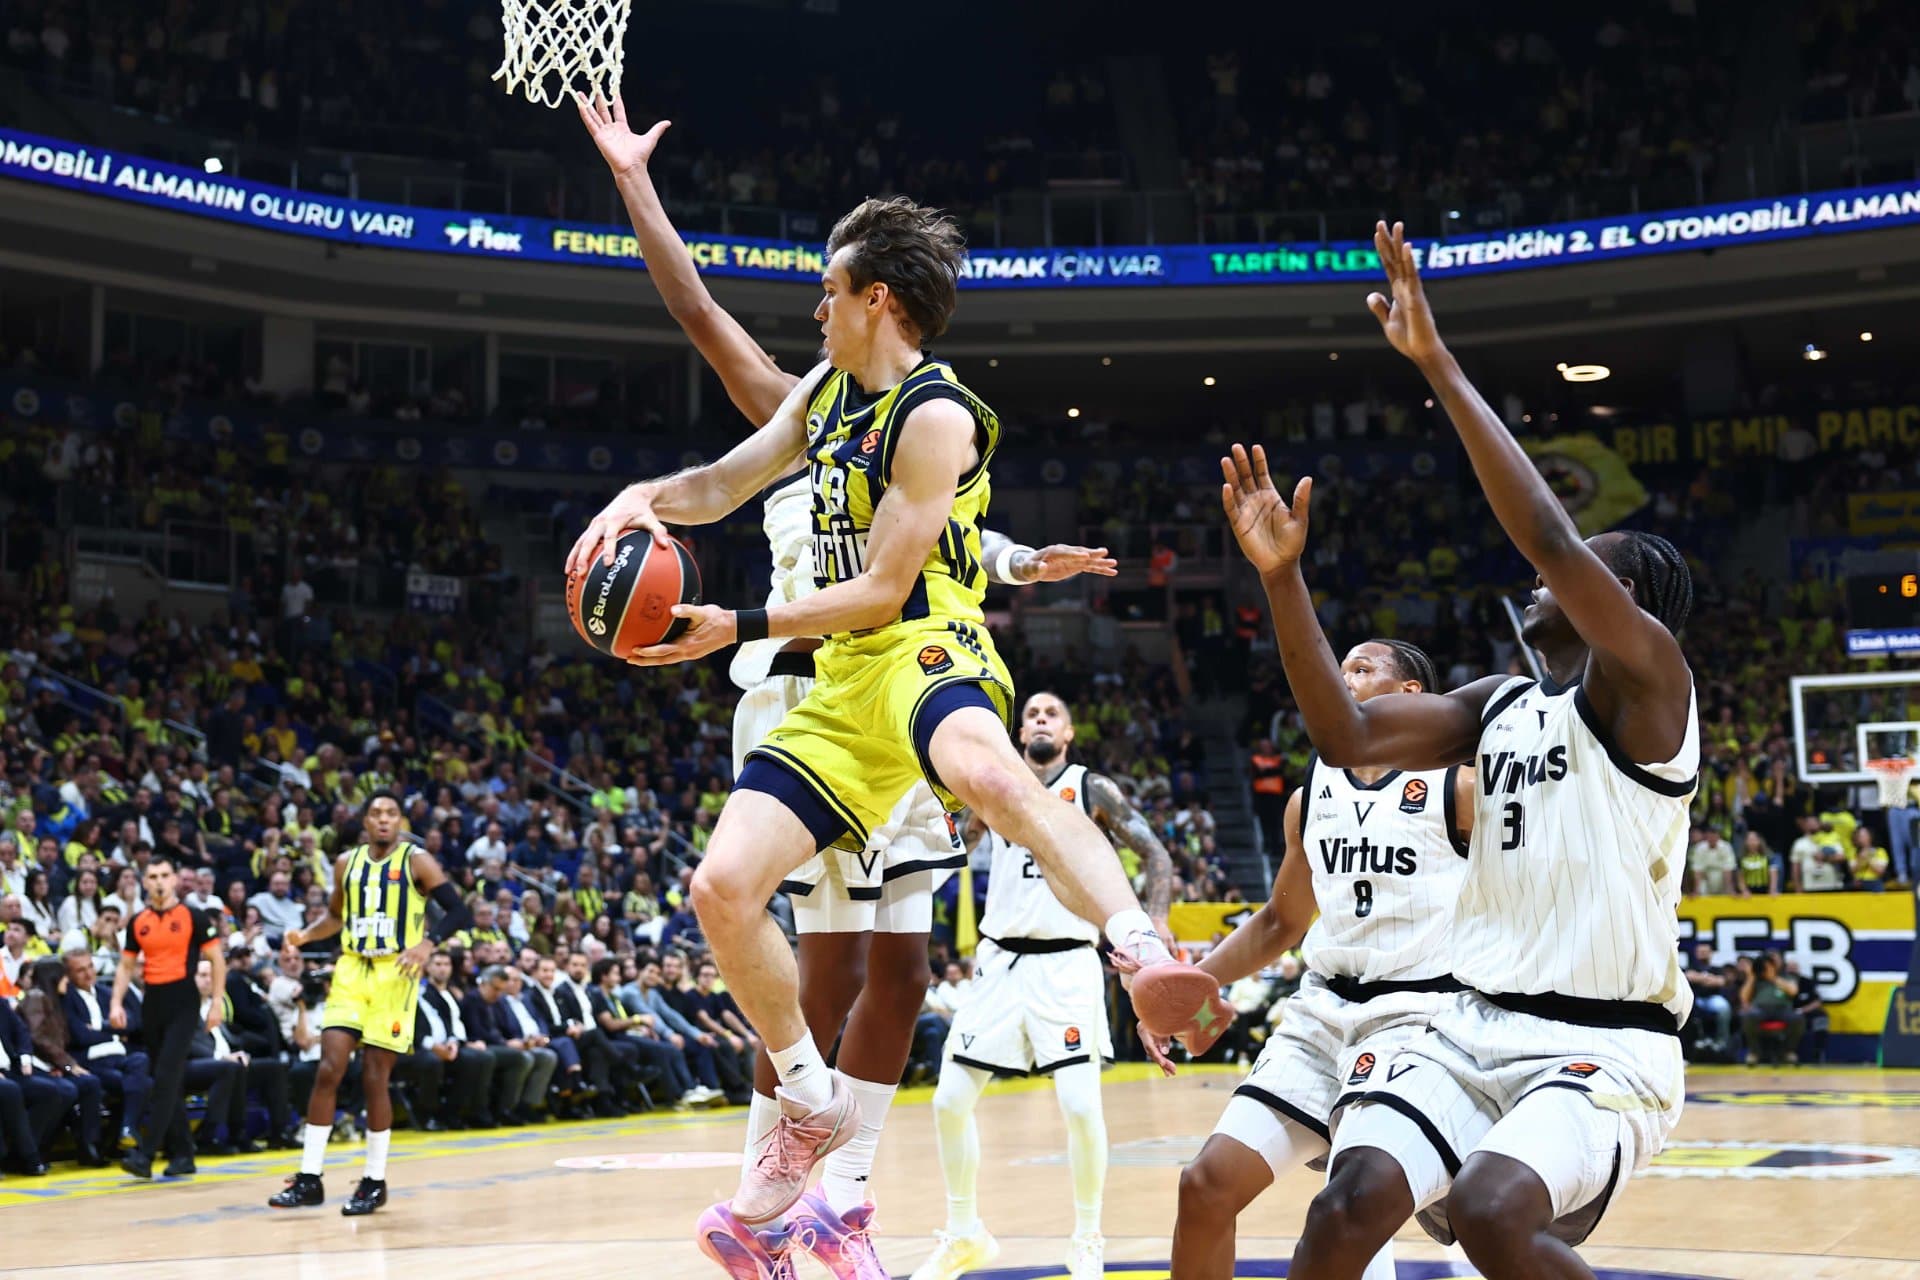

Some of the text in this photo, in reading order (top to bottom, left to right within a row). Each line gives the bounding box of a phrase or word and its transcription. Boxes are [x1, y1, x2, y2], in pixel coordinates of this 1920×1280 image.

[114, 160, 246, 212] ALMANIN
[250, 192, 345, 230] OLURU
[349, 210, 414, 239] VAR!
[468, 219, 522, 252] Flex
[553, 230, 728, 273] FENERÇE
[1427, 229, 1562, 269] İSTEDİĞİN
[1567, 230, 1595, 254] 2.
[1599, 225, 1636, 250] EL
[1640, 198, 1810, 244] OTOMOBİLİ
[1051, 255, 1103, 282] İÇİN
[1211, 248, 1308, 273] TARFİN
[1900, 574, 1918, 598] 6
[1319, 836, 1418, 876] Virtus
[1354, 880, 1374, 918] 8
